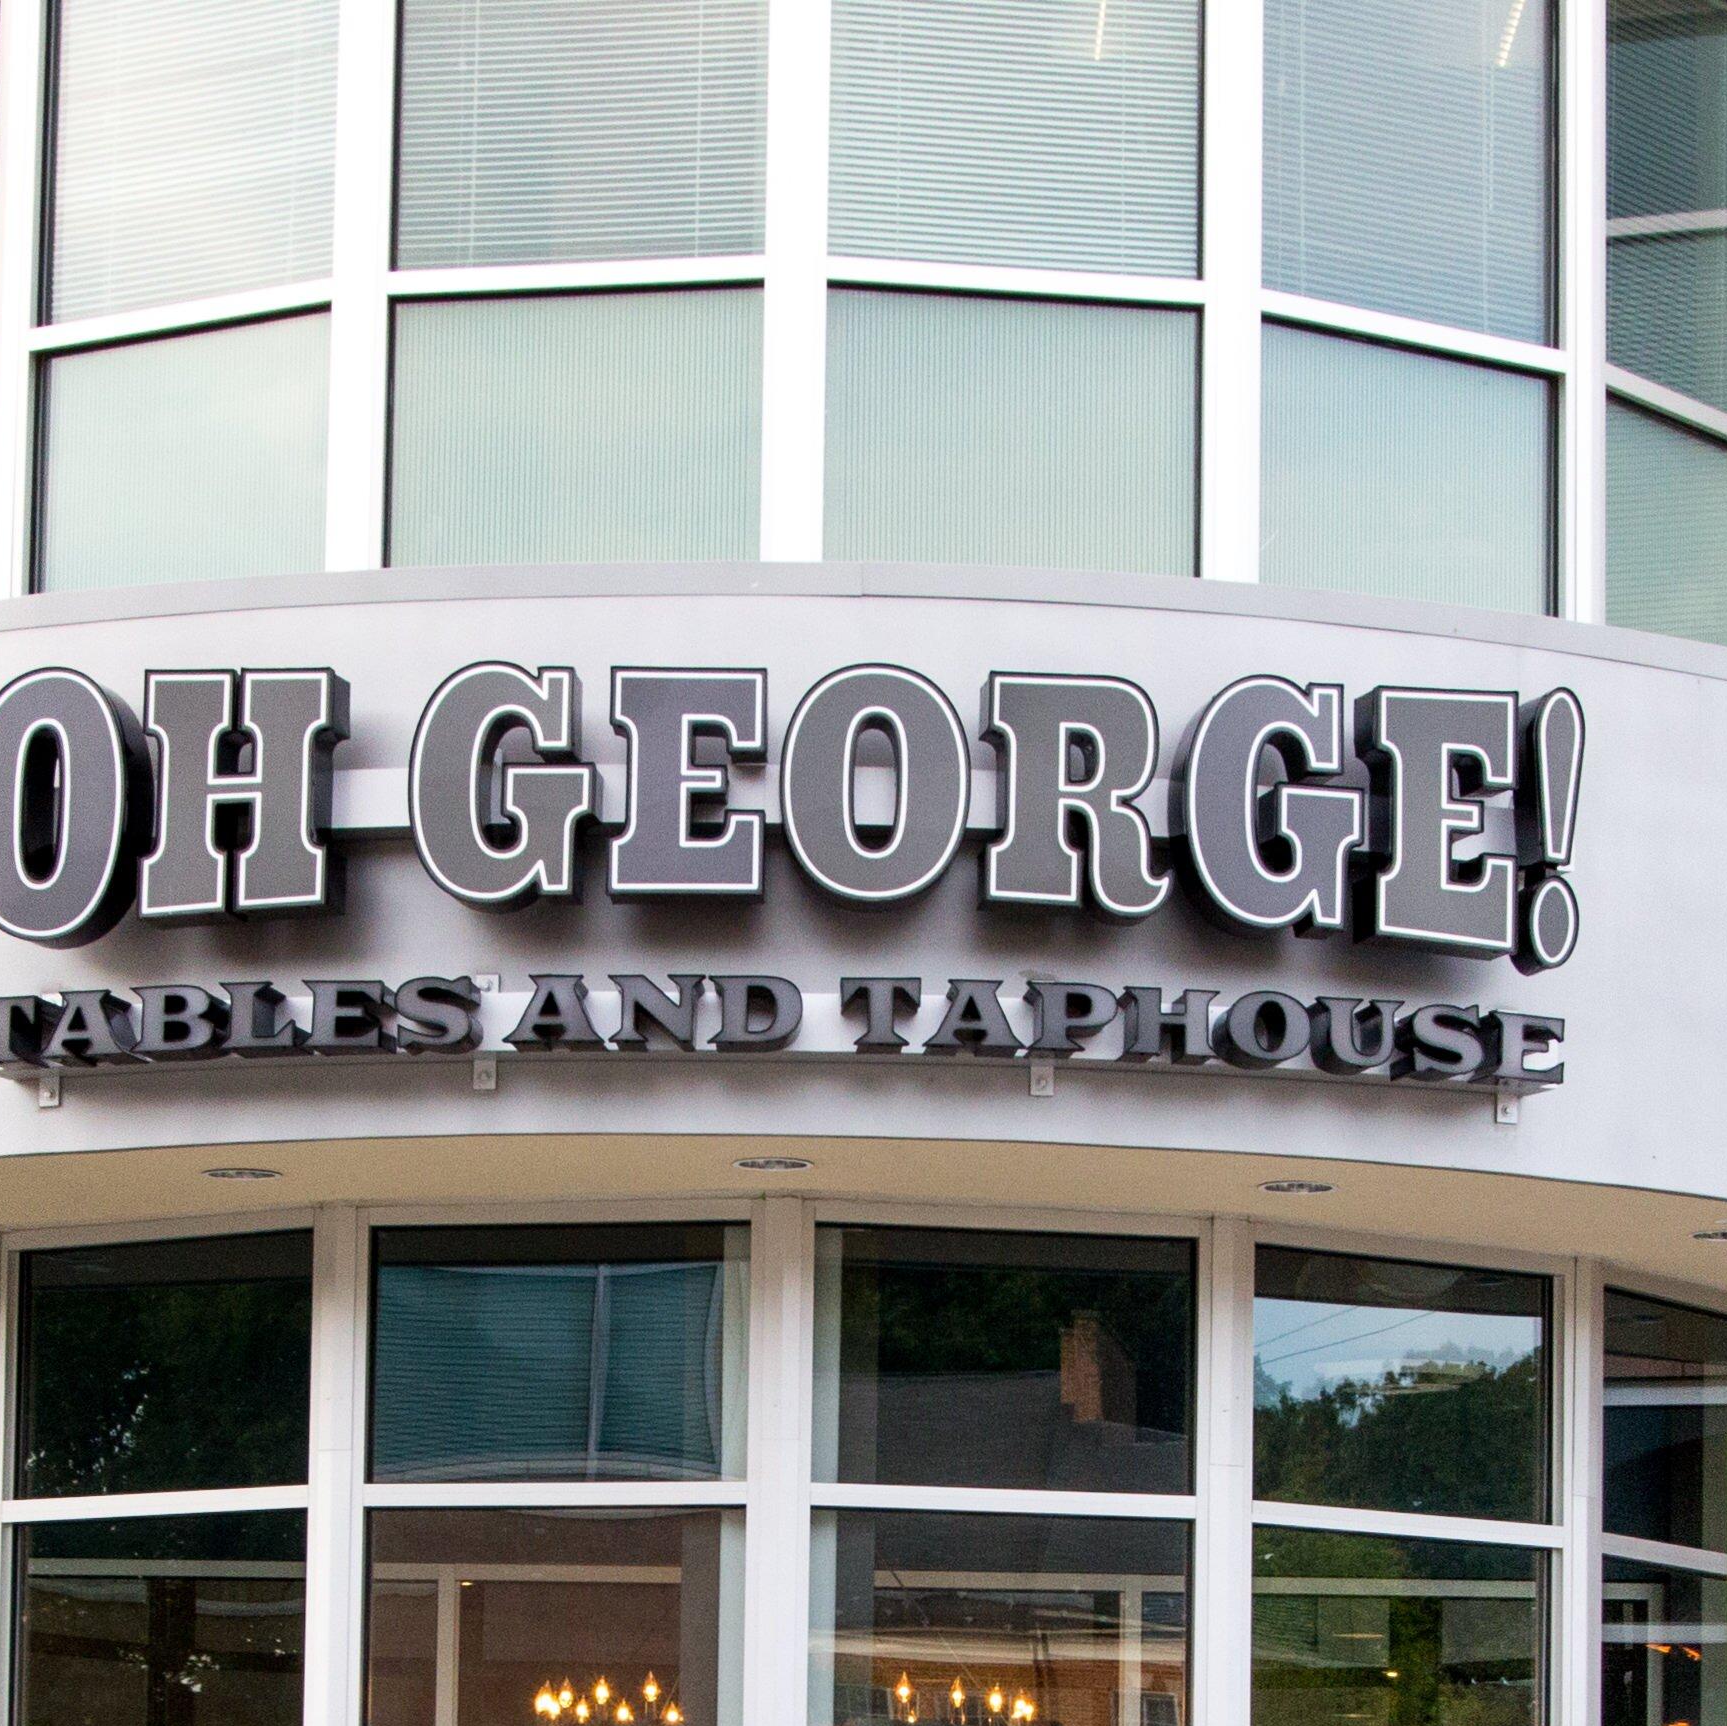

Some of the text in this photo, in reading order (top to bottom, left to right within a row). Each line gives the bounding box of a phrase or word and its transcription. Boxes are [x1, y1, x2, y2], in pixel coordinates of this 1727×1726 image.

[408, 660, 1586, 975] GEORGE!
[503, 971, 806, 1055] AND
[840, 976, 1568, 1086] TAPHOUSE
